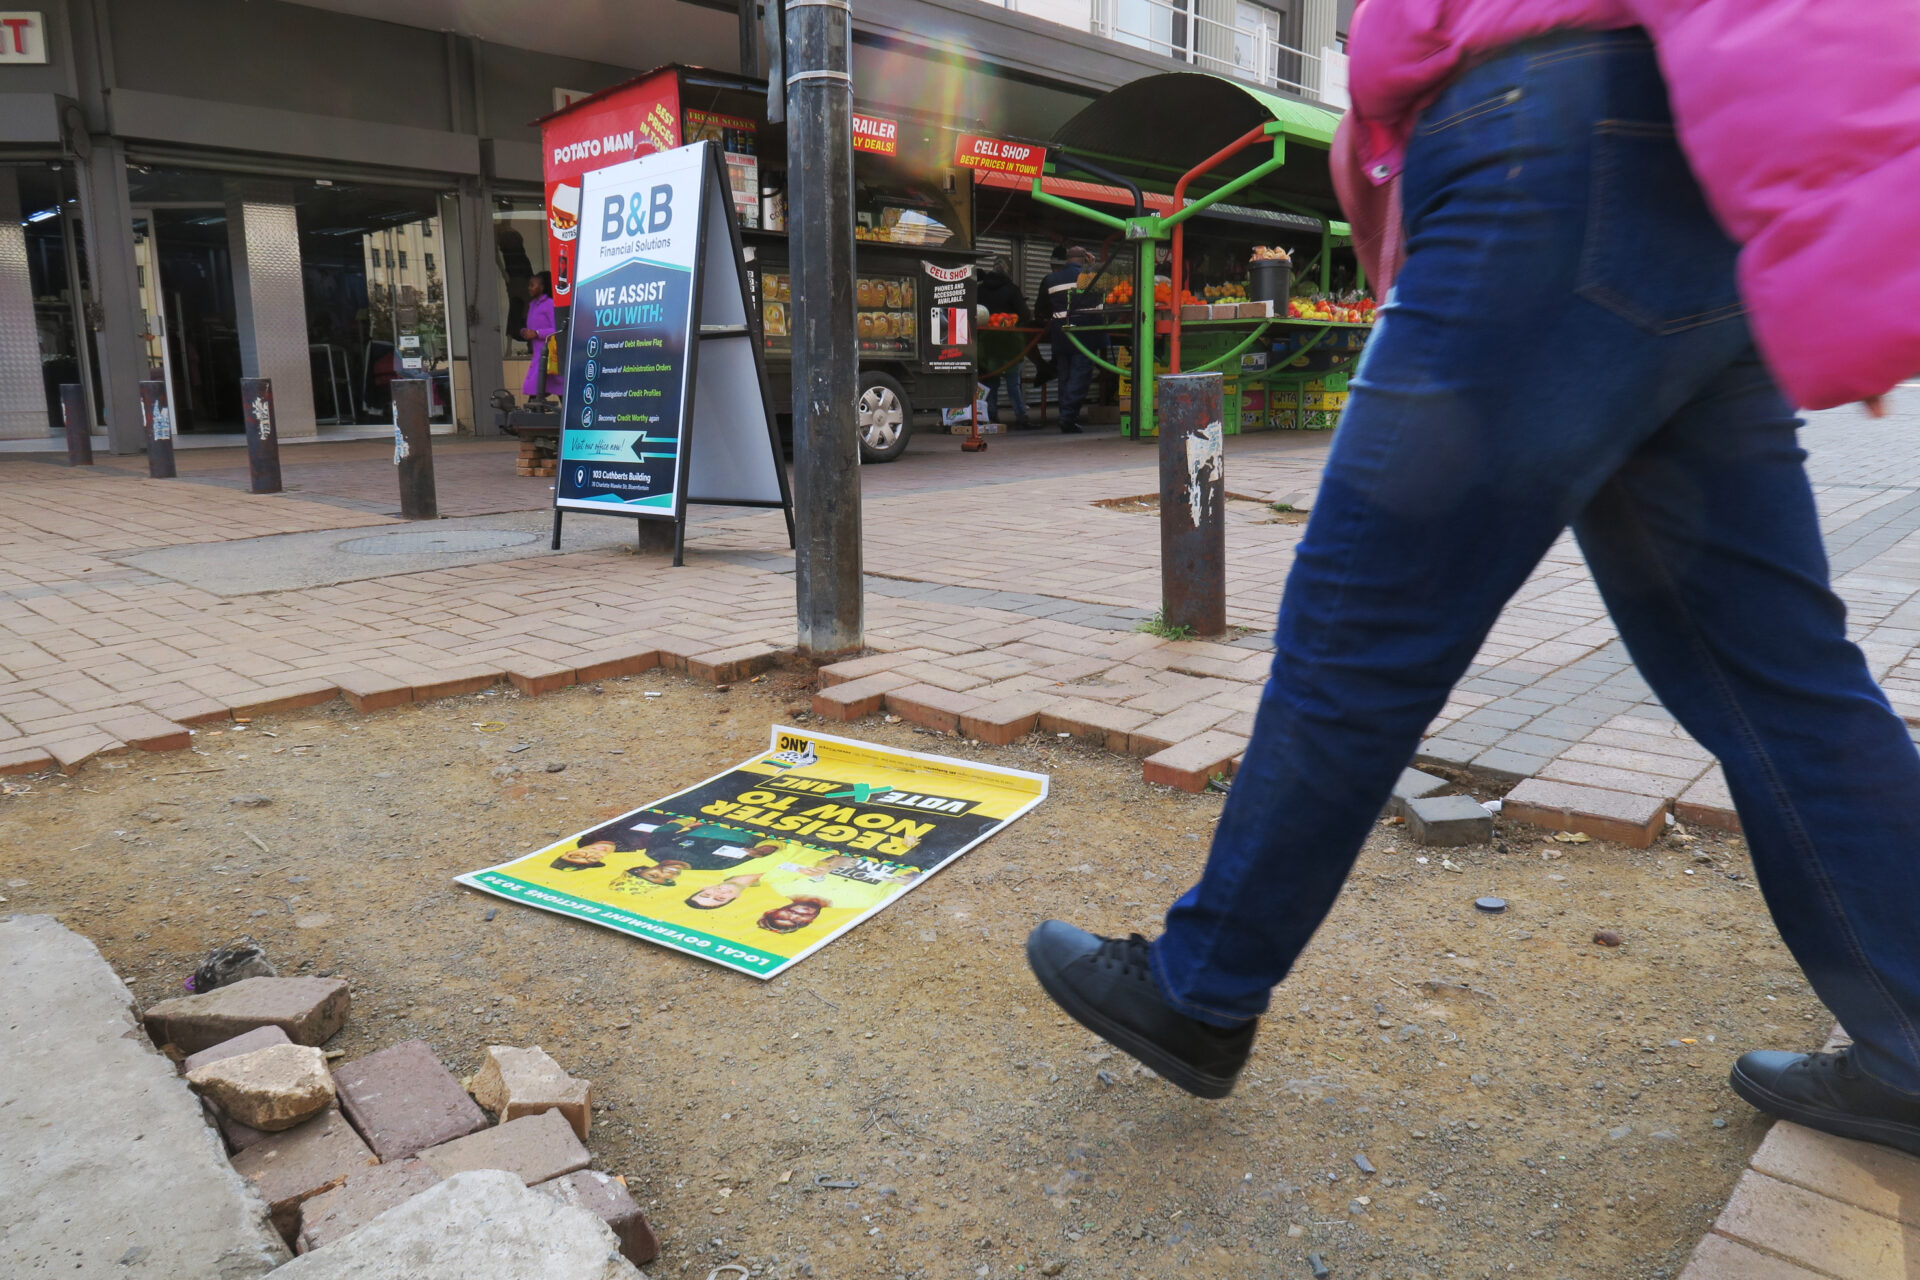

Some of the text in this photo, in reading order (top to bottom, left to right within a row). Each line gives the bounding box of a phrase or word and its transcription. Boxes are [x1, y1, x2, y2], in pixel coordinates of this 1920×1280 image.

[656, 103, 675, 126] BEST
[689, 111, 718, 122] FRESH
[640, 121, 650, 136] IN
[647, 112, 675, 146] PRICES
[853, 117, 895, 139] RAILER
[554, 130, 634, 165] POTATO MAN
[864, 138, 895, 153] DEALS!
[974, 140, 1030, 161] CELL SHOP
[960, 154, 1039, 175] BEST PRICES IN TOWN!
[602, 184, 673, 242] B&B
[600, 236, 671, 258] Financial Solutions
[929, 266, 968, 280] CELL SHOP
[595, 280, 666, 307] WE ASSIST
[933, 288, 966, 299] ACCESSORIES
[934, 282, 965, 293] PHONES AND
[594, 303, 664, 327] YOU WITH:
[624, 340, 636, 348] Debt
[636, 339, 652, 347] Review
[653, 338, 663, 348] Flag
[623, 365, 655, 373] Administration
[655, 364, 672, 372] Orders
[628, 389, 642, 397] Credit
[643, 389, 662, 397] Profiles
[616, 414, 631, 422] Credit
[631, 414, 648, 423] Worthy
[571, 437, 584, 451] Visit
[594, 440, 609, 454] office
[592, 470, 651, 483] 103 Cuthberts Building
[781, 735, 808, 752] ANC
[769, 778, 968, 813] VOTE ANC
[737, 790, 936, 838] NOW TO
[700, 799, 920, 856] REGISTER
[483, 875, 770, 966] LOCAL GOVERNMENT ELECTIONS 2026
